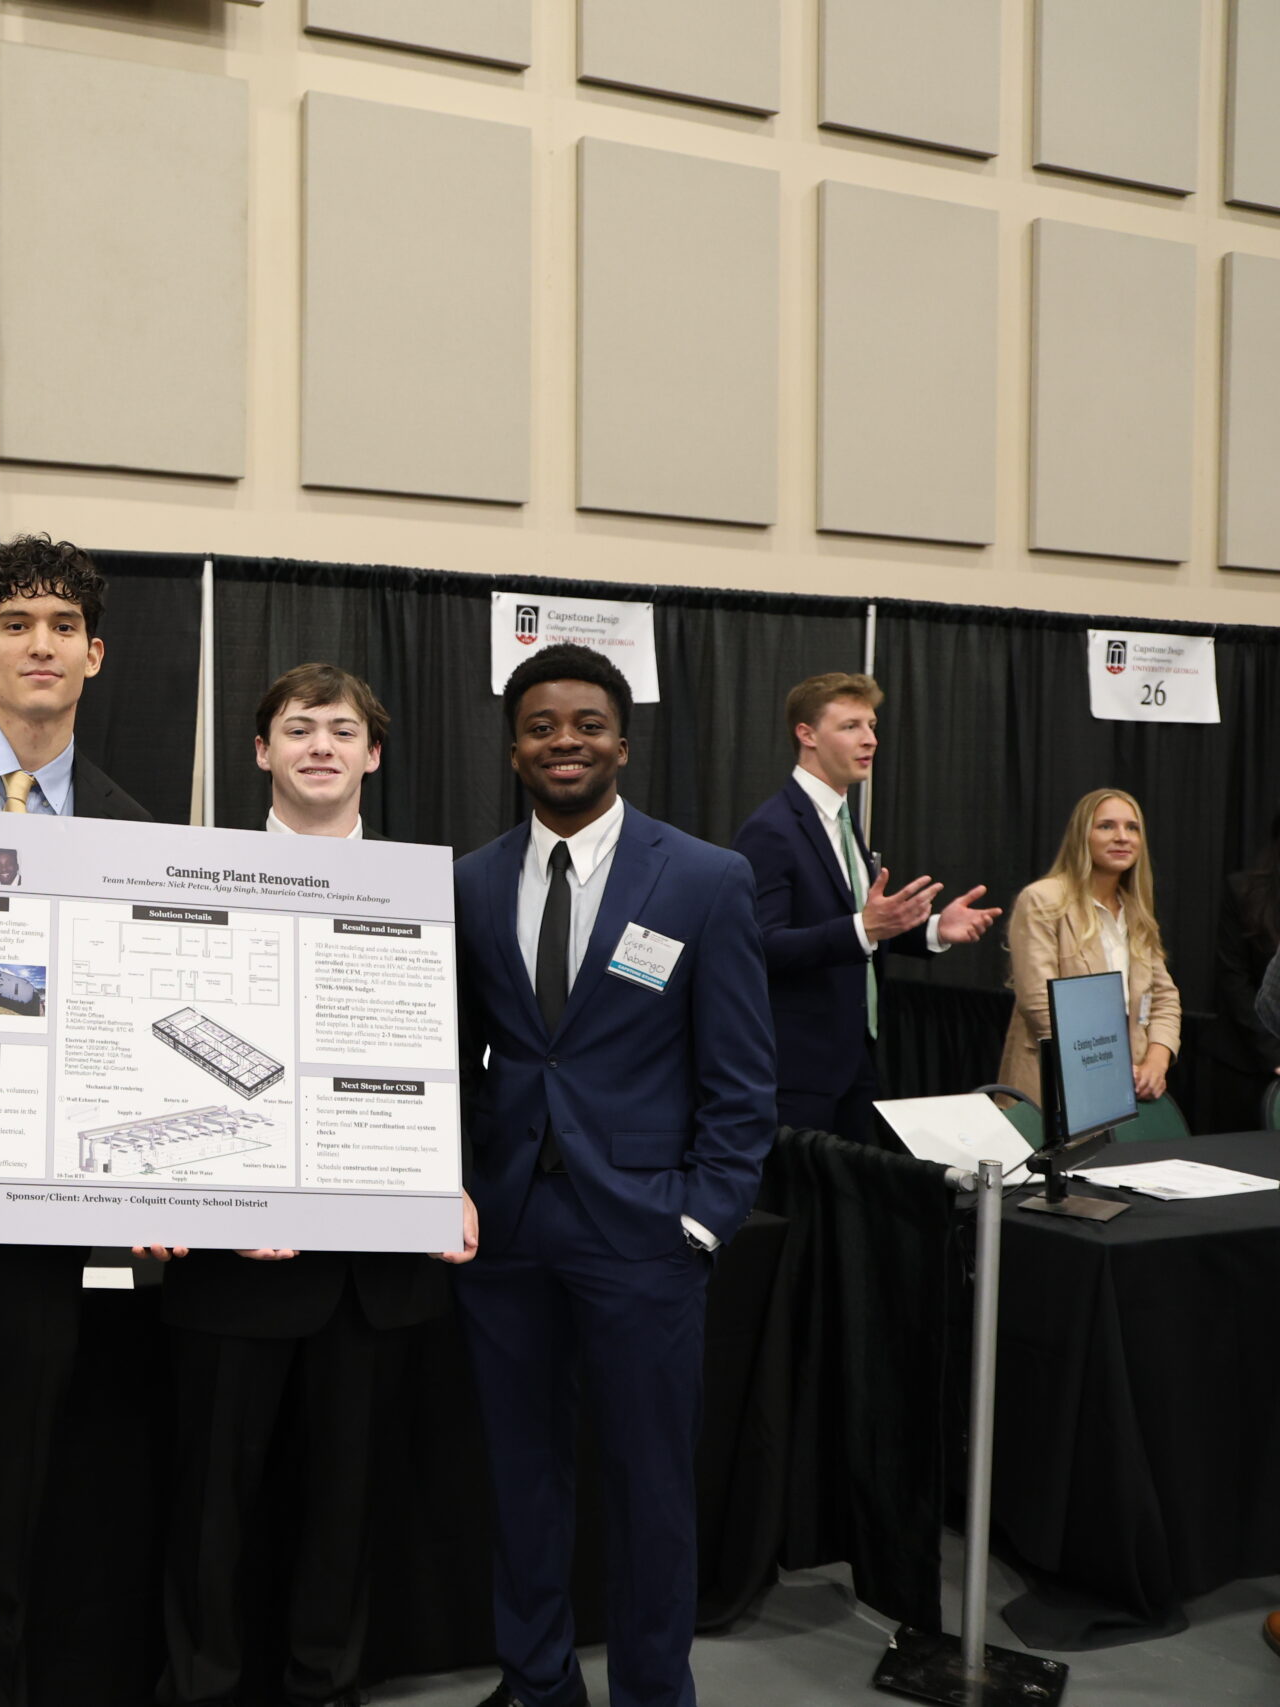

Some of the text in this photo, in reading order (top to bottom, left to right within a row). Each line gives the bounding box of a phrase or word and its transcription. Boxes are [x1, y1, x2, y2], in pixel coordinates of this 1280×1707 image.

[547, 611, 595, 623] Capstone
[545, 635, 635, 646] UNIVERSITY OF GEORGIA
[1133, 645, 1167, 655] Capstone
[1141, 680, 1166, 706] 26
[166, 866, 330, 888] Canning Plant Renovation
[126, 878, 166, 887] Members:
[187, 882, 212, 891] Petcu,
[213, 884, 230, 893] Ajay
[231, 885, 258, 894] Singh,
[260, 887, 296, 896] Mauricio
[298, 890, 326, 899] Castro,
[326, 891, 354, 901] Crispin
[356, 893, 391, 904] Kabongo
[149, 910, 212, 921] Solution Details
[342, 924, 370, 932] Results
[387, 926, 413, 935] Impact
[6, 1087, 39, 1095] volunteers)
[360, 1083, 381, 1092] Steps
[370, 1110, 392, 1118] funding
[317, 1142, 340, 1150] Prepare
[390, 1166, 421, 1174] inspections
[6, 1191, 268, 1208] Sponsor/Client: Archway Colquitt County School District
